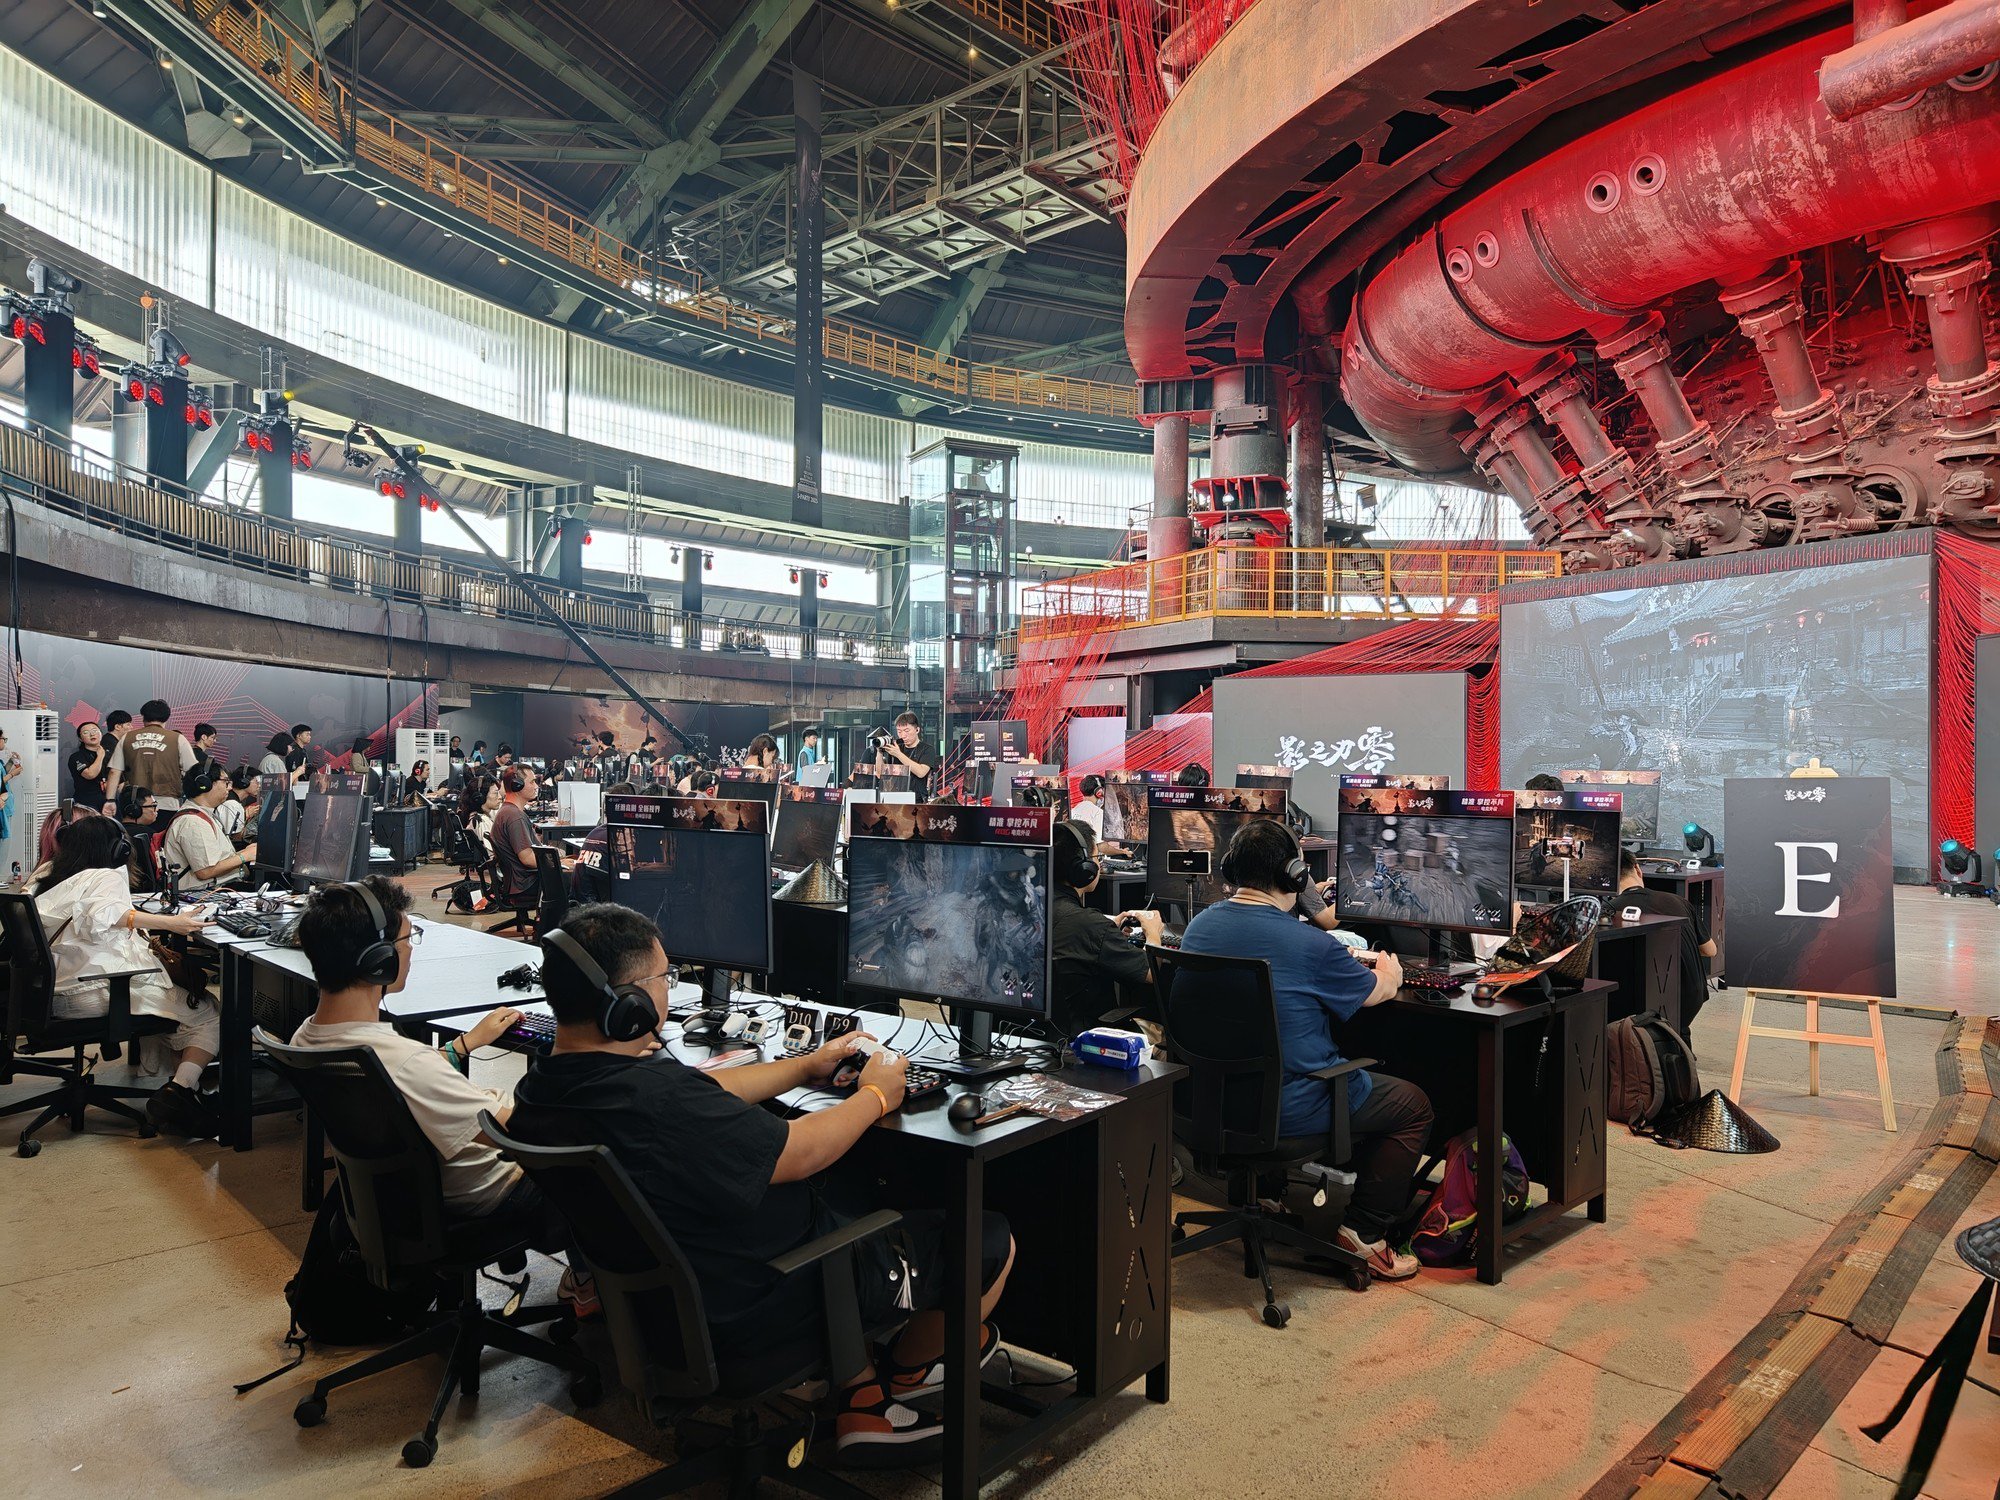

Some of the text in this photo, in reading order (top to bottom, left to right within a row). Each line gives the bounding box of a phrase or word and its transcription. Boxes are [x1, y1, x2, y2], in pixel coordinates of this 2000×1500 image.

[1274, 726, 1395, 775] 影之刃零
[1784, 787, 1826, 803] 影之刃零
[1774, 842, 1840, 919] E
[788, 1011, 812, 1027] D10
[832, 1016, 850, 1032] D9
